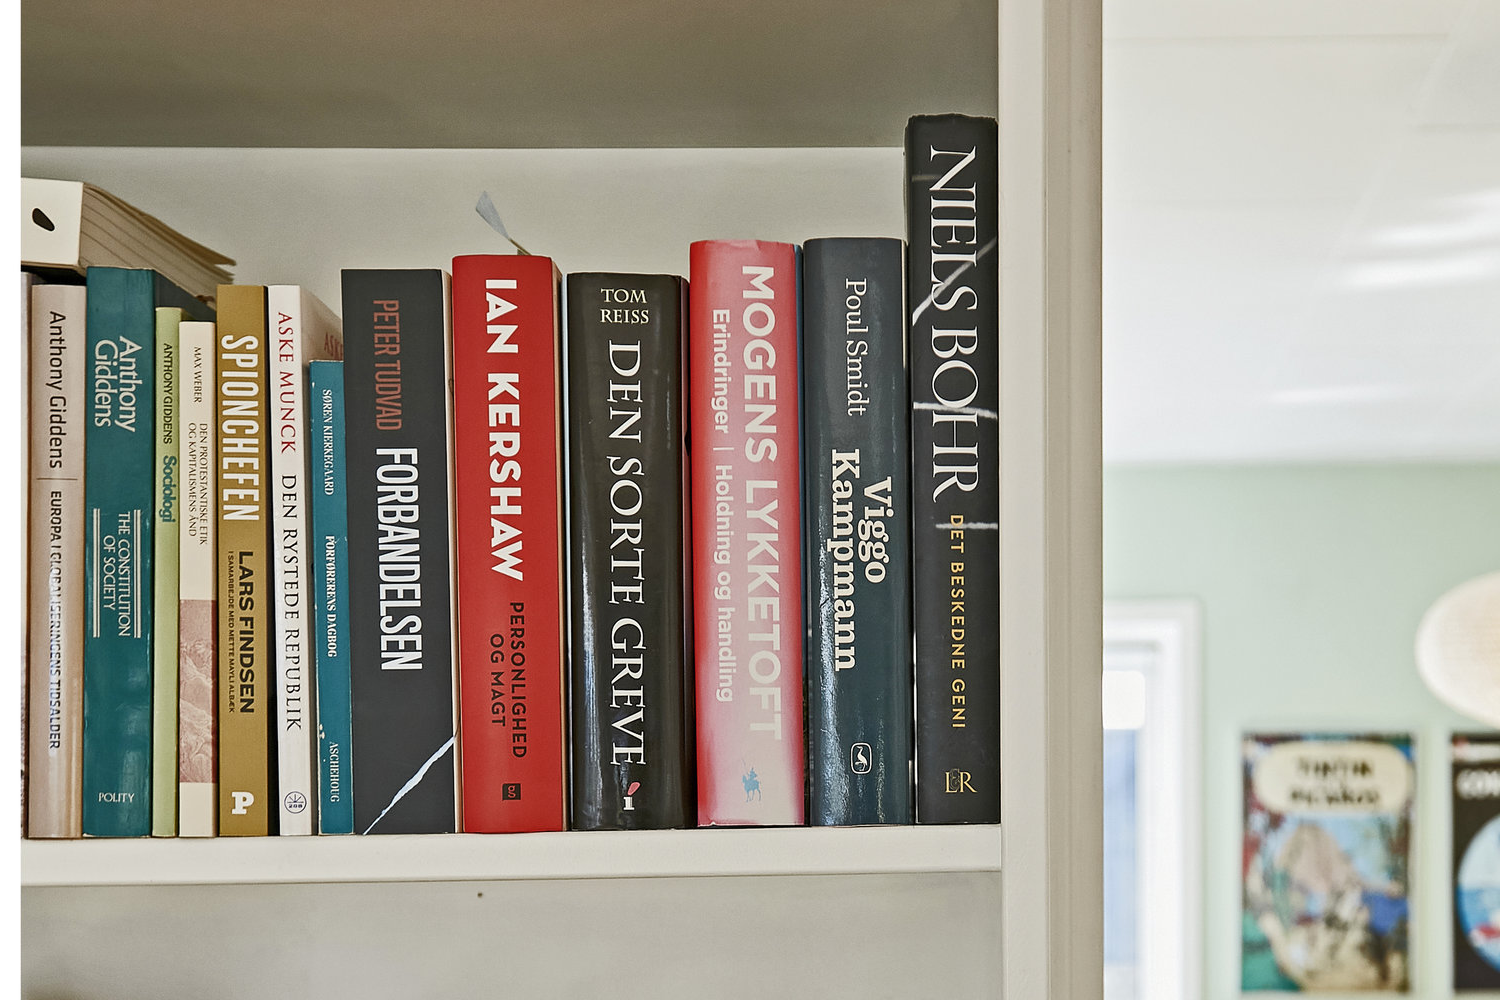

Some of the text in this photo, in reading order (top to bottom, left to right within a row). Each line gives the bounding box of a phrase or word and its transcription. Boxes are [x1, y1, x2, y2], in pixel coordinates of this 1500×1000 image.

[601, 288, 647, 304] TOM
[601, 308, 650, 325] REISS
[844, 278, 867, 416] Poul Smidt
[930, 147, 979, 501] NIELS BOHR
[46, 311, 67, 469] Anthony Giddens
[94, 339, 118, 428] Giddens
[115, 335, 143, 433] Anthony
[221, 335, 259, 521] SPIONCHEFEN
[372, 298, 402, 431] PETER TUDVAD
[485, 279, 524, 582] IAN KERSHAW
[711, 308, 730, 435] Erindringer
[160, 455, 177, 524] Sociologi
[278, 311, 302, 731] ASKE MUNCK DEN RYSTEDE REPUBLIK
[607, 340, 646, 767] DEN SORTE GREVE
[712, 464, 733, 575] Holdning
[742, 264, 782, 742] MOGENS LYKKETOFT
[859, 475, 895, 584] Viggo
[102, 554, 116, 610] SOCIETY
[117, 539, 131, 637] CONSTITUTION
[376, 446, 423, 671] FORBANDELSEN
[826, 448, 860, 671] Kampmann
[950, 513, 965, 729] DET BESKEDNE GENI
[238, 551, 255, 714] LARS FINDSEN
[490, 634, 505, 727] OG MAGT
[510, 601, 527, 759] PERSONLIGHED
[715, 606, 735, 704] handling
[48, 680, 62, 749] TIDSALDER
